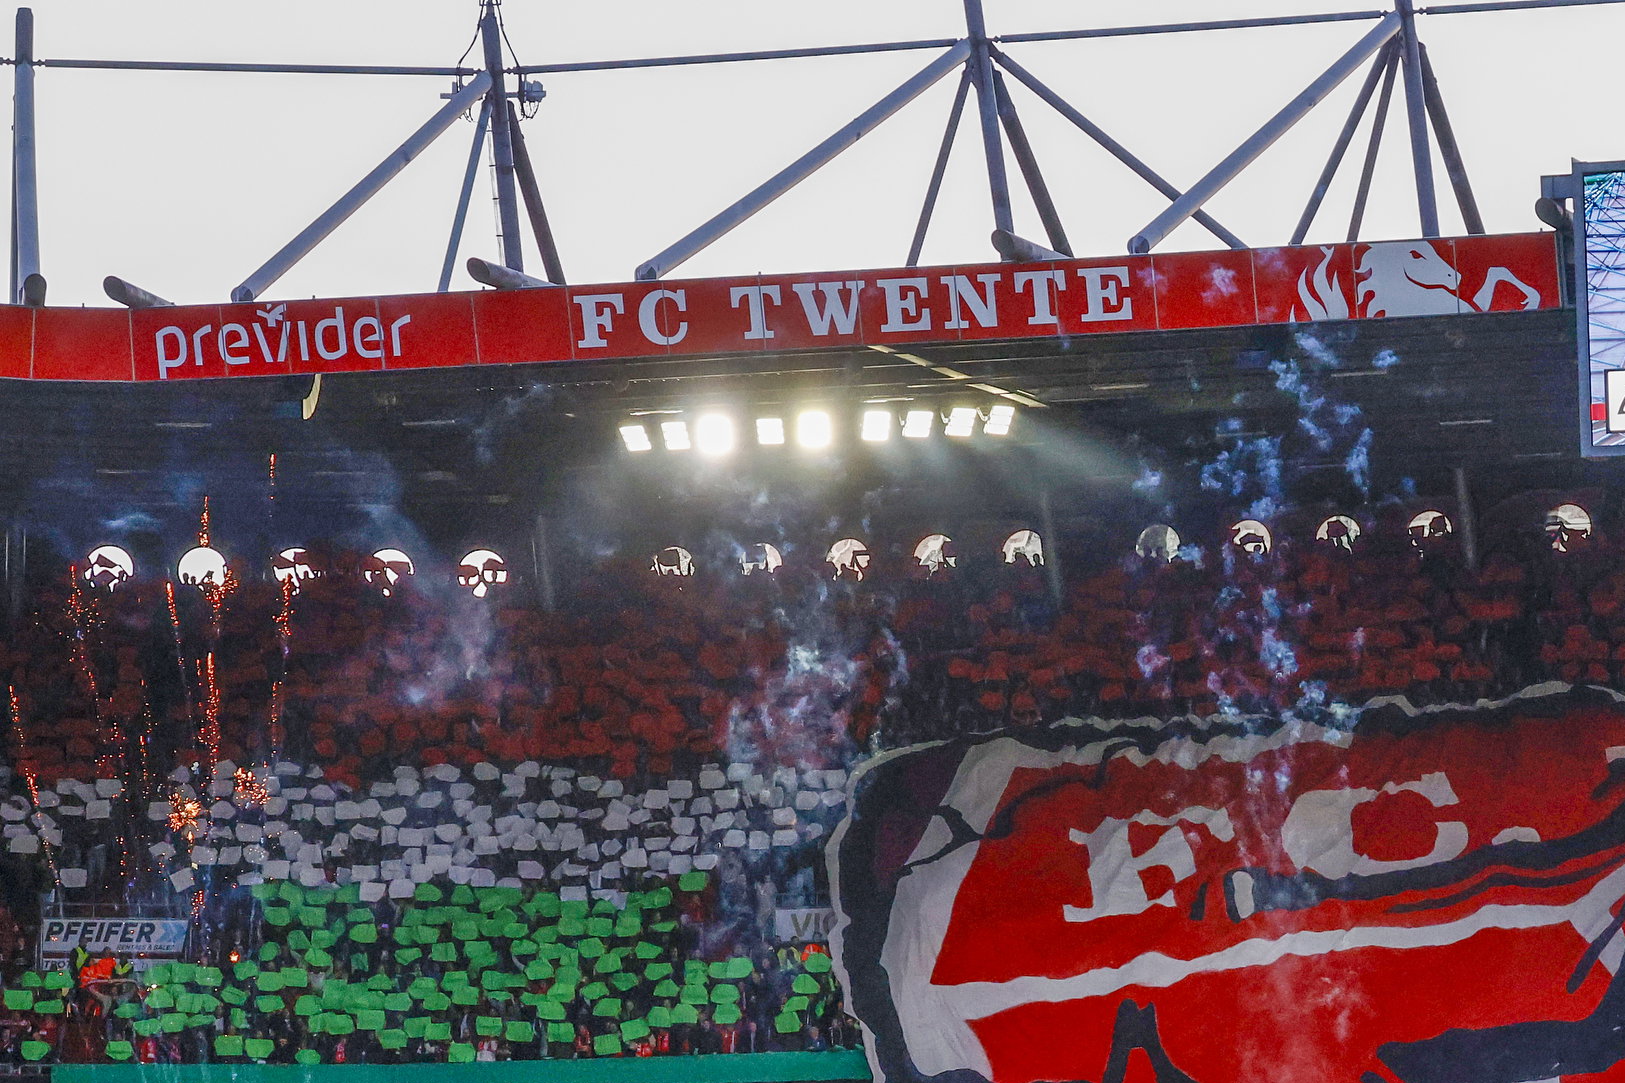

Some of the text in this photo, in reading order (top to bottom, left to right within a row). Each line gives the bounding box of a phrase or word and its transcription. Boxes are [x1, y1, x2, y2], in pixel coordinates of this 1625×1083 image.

[155, 304, 412, 379] previder
[572, 265, 1133, 349] FC TWENTE
[45, 921, 156, 943] PFEIFER
